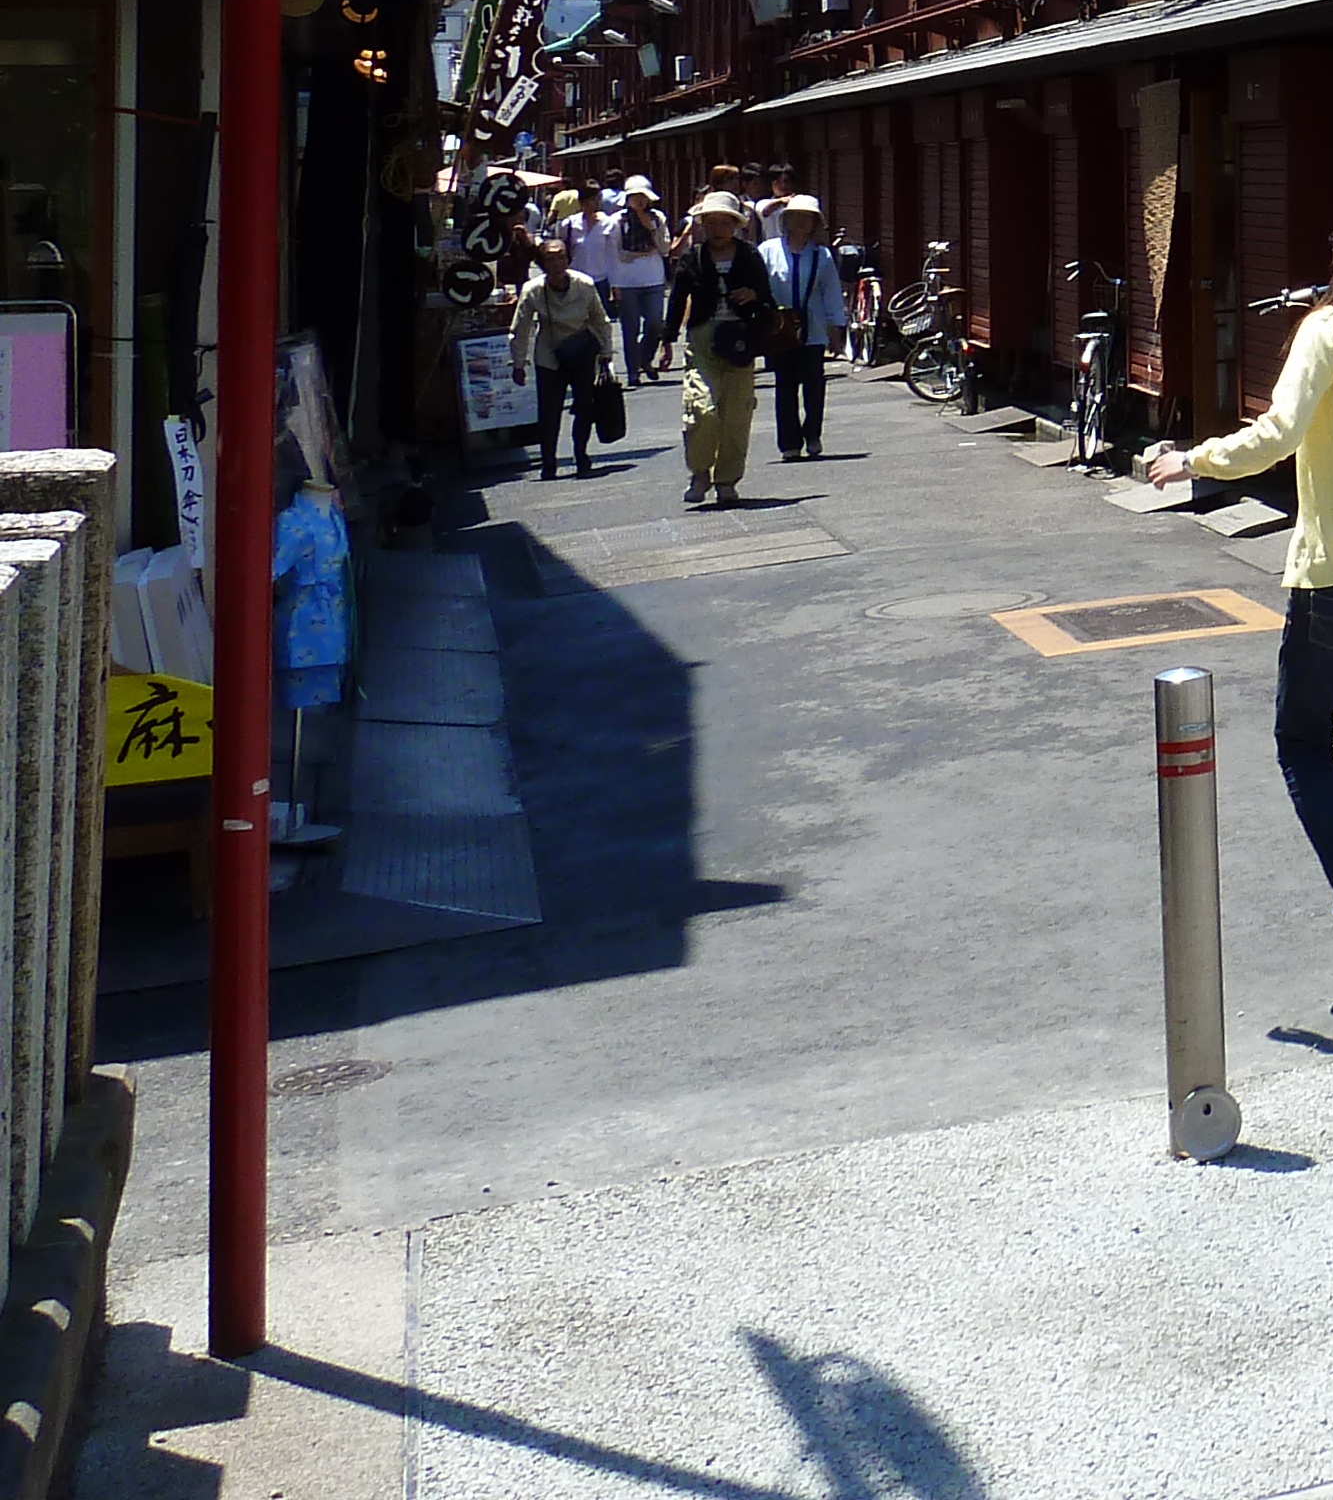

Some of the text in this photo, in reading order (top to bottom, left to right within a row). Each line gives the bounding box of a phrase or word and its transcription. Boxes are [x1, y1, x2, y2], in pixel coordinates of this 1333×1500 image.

[447, 173, 524, 304] だんご
[116, 681, 212, 764] 麻
